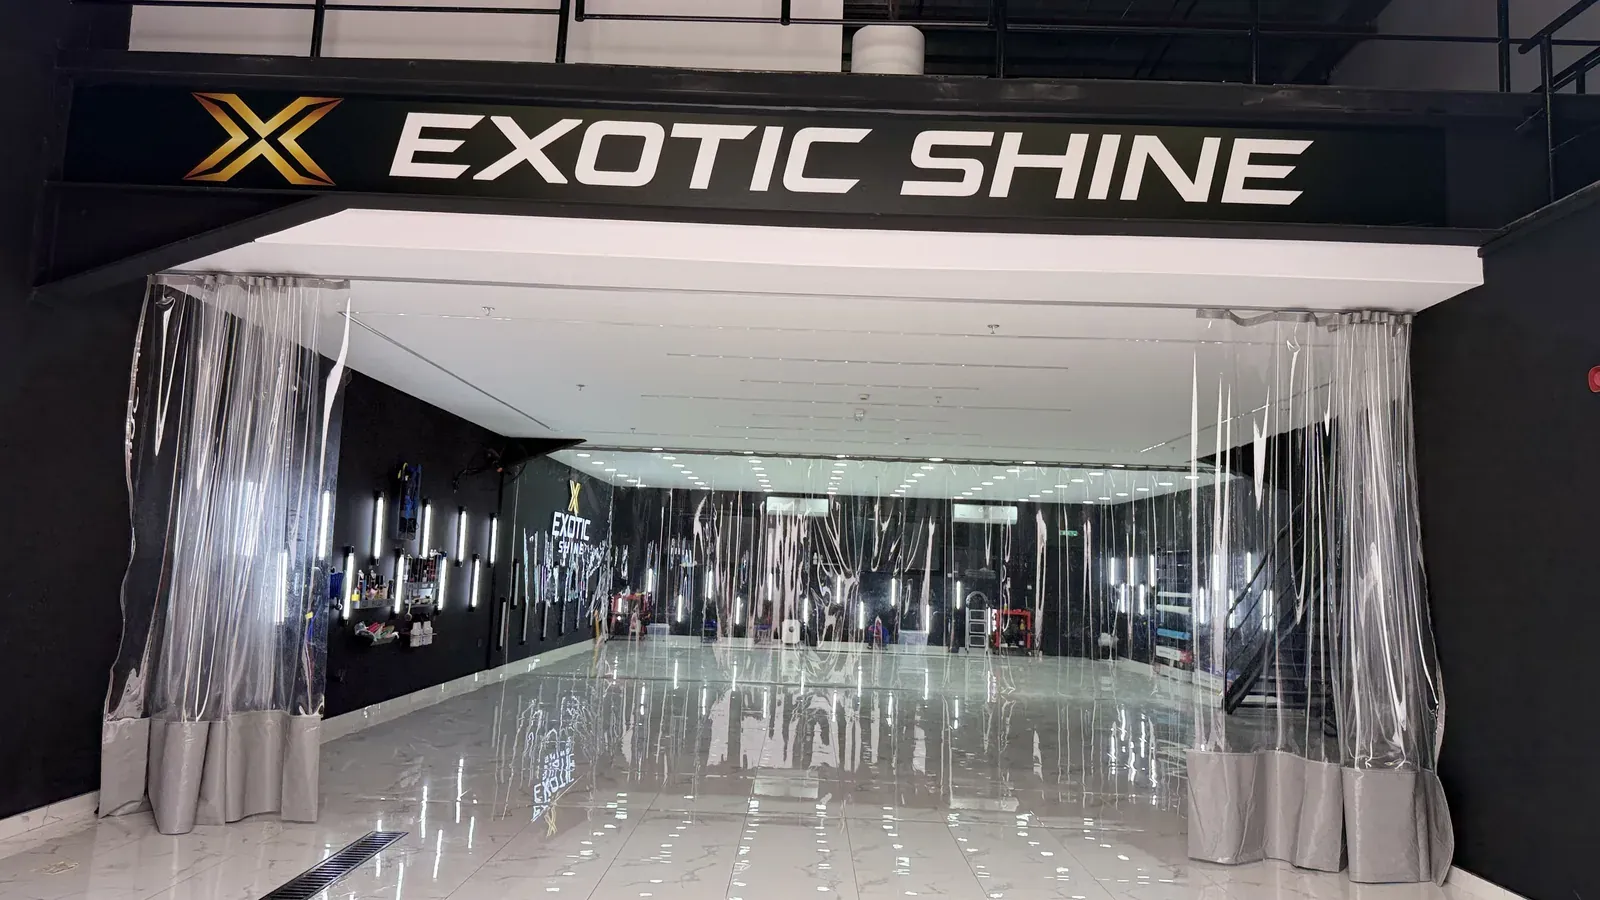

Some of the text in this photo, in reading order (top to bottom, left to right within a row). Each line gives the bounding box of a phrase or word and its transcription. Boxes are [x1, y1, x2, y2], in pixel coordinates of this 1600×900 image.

[389, 111, 1315, 206] EXOTIC SHINE
[551, 511, 592, 541] EXOTIC
